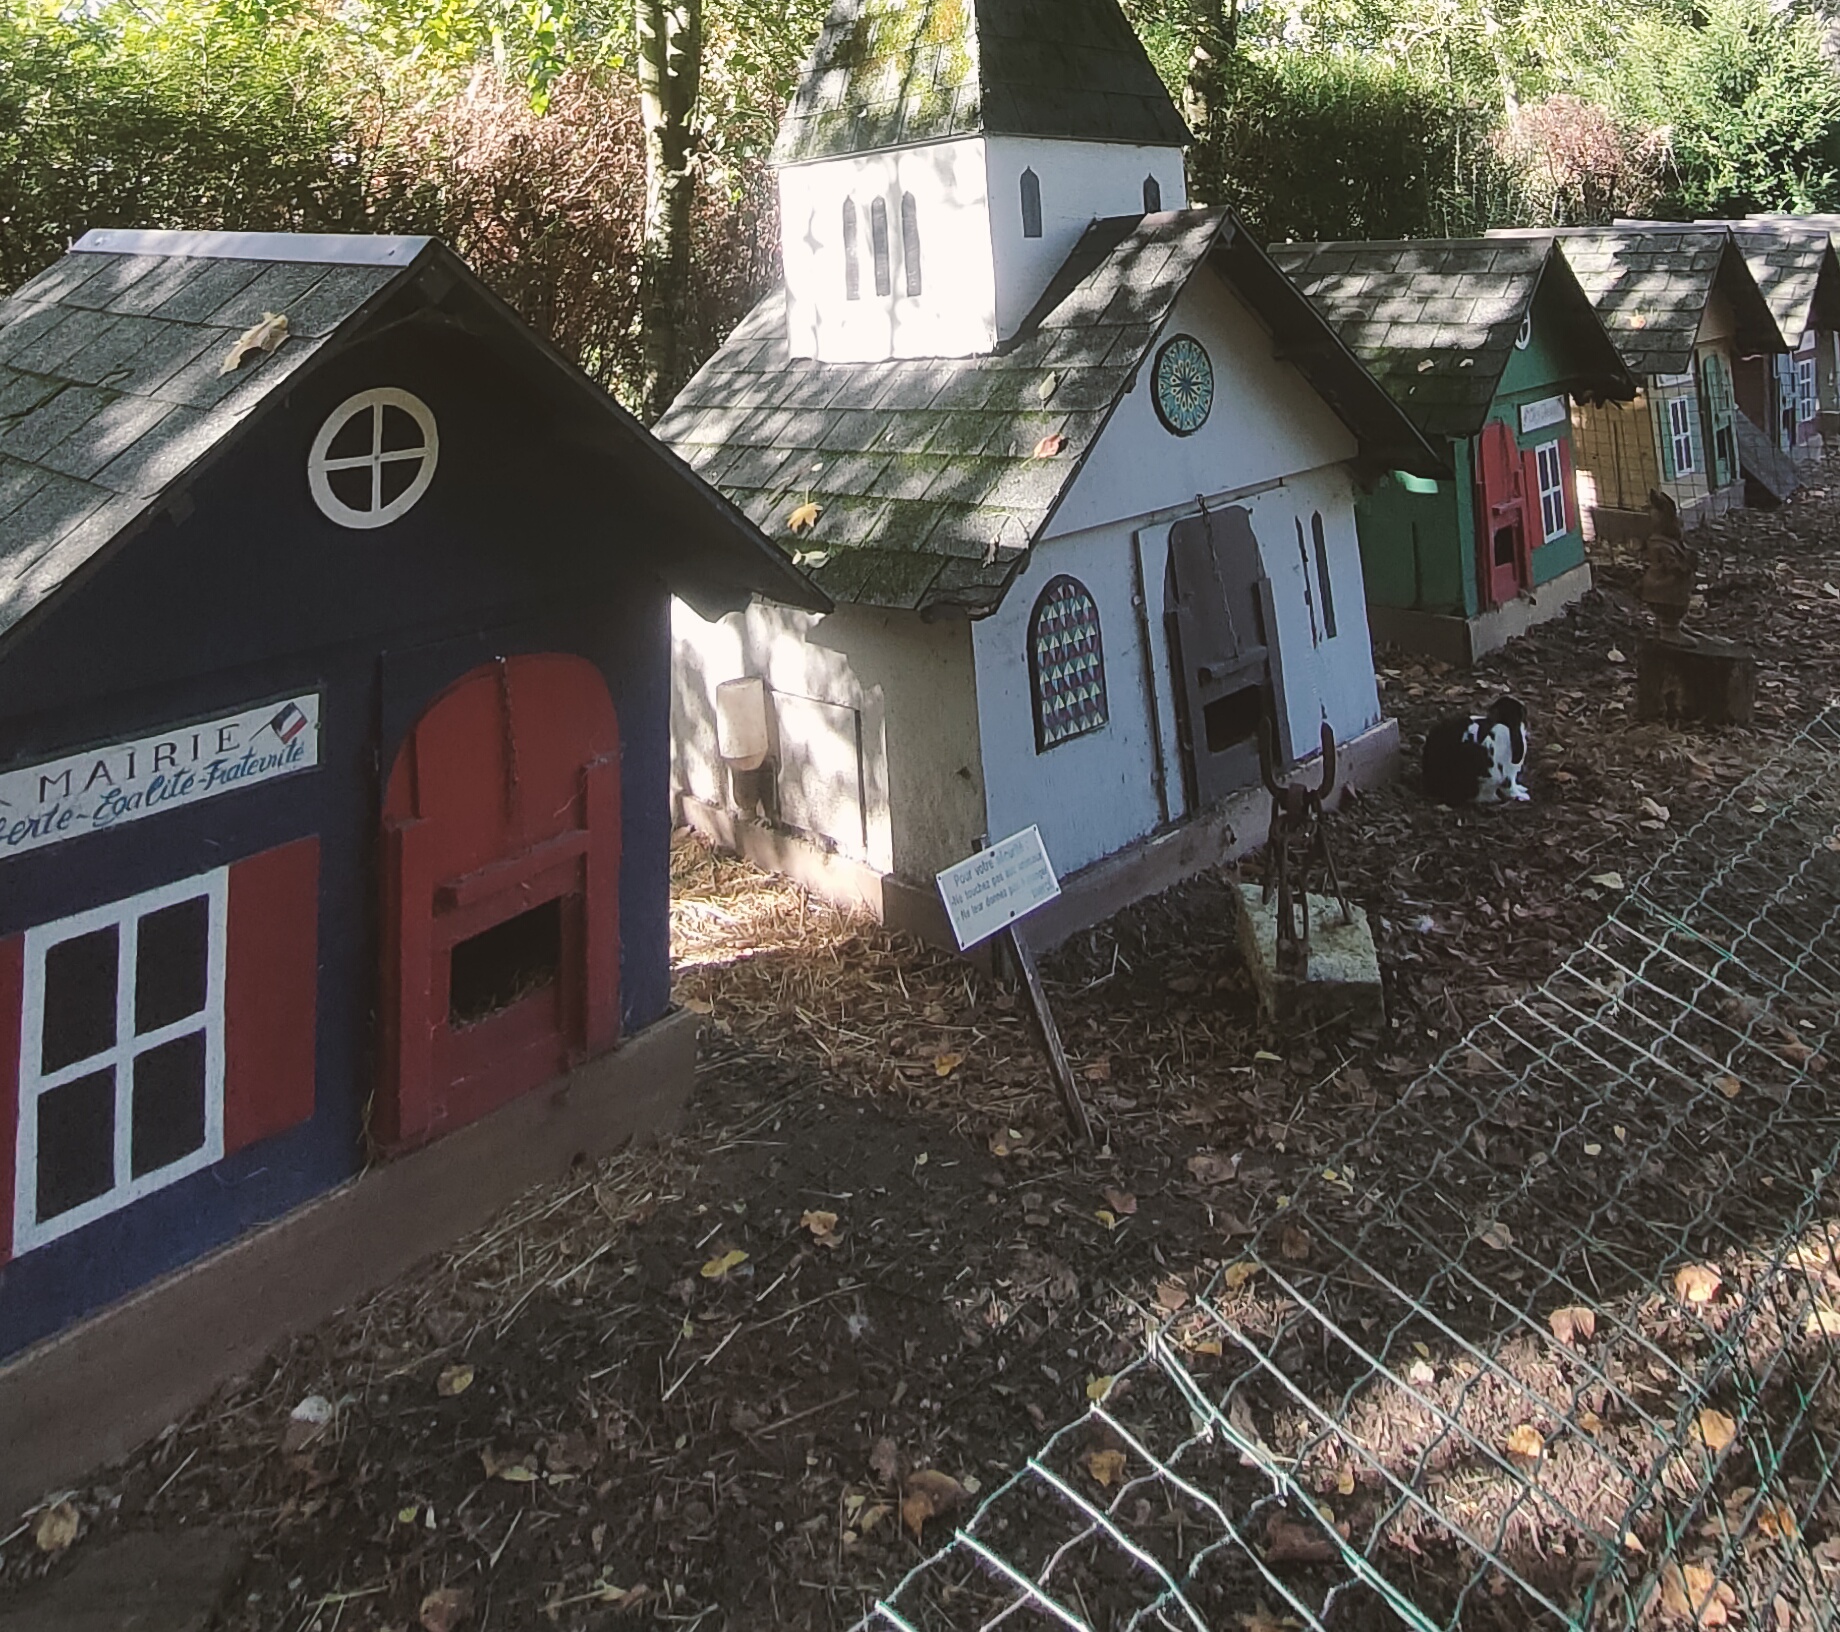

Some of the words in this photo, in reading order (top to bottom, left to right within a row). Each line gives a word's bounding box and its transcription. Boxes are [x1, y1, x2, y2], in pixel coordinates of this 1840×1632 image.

[39, 723, 241, 803] MAIRIE
[953, 869, 973, 887] Pour
[974, 859, 994, 876] votre
[964, 880, 990, 900] touchez
